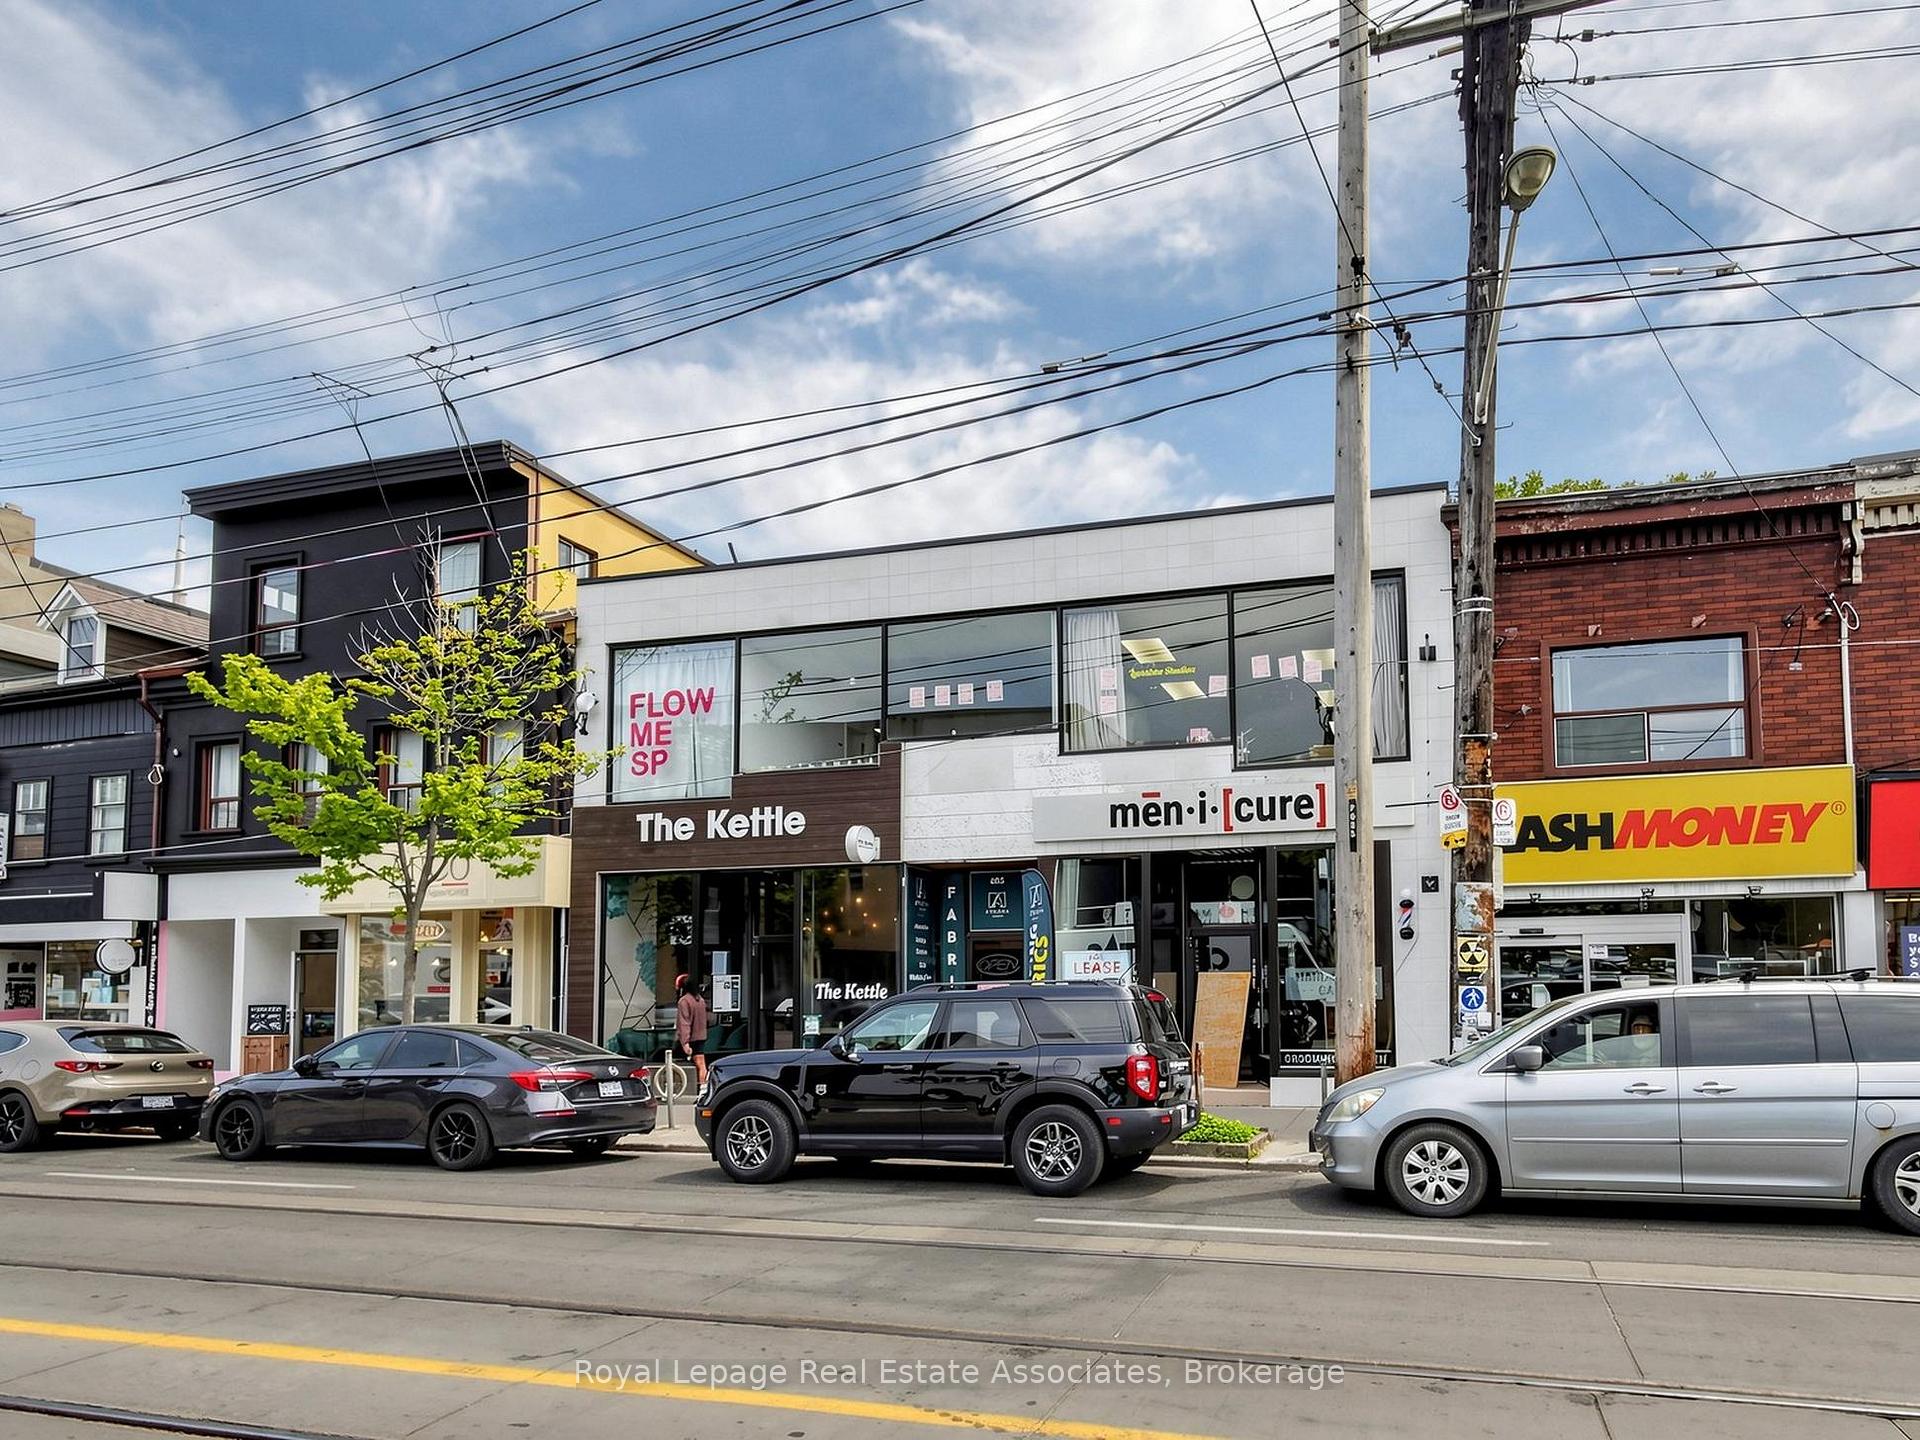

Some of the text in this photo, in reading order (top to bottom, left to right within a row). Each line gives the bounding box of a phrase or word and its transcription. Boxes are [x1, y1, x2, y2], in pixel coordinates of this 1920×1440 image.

[629, 686, 716, 720] FLOW
[629, 720, 672, 748] ME
[630, 748, 670, 778] SP
[636, 804, 807, 843] The Kettle
[1502, 800, 1830, 855] ASHMONEY
[1073, 961, 1121, 975] LEASE
[814, 982, 888, 1000] The Kettle
